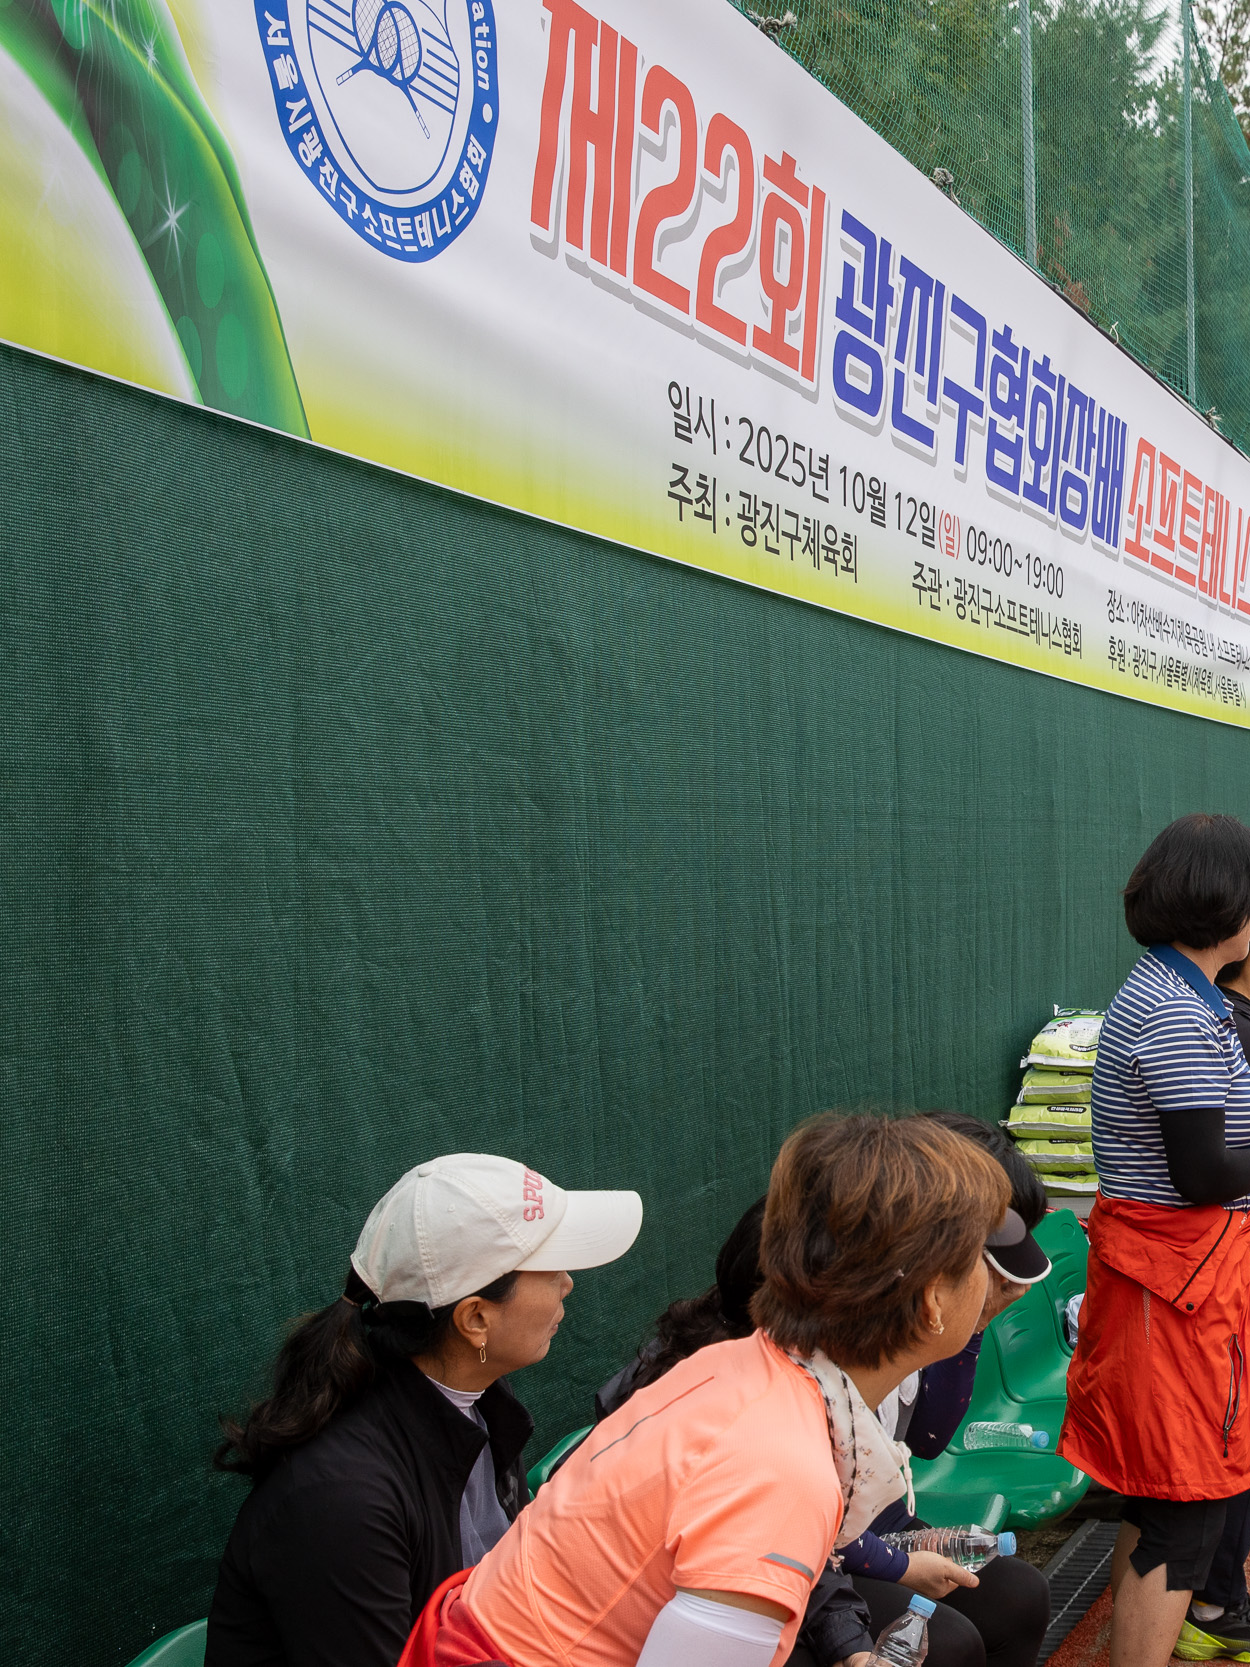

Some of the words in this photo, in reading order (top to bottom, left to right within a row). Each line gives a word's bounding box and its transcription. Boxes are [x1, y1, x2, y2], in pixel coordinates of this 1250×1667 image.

[530, 0, 826, 383] 제22회
[833, 209, 1127, 550] 광진구협회장배
[668, 380, 717, 455] 일시
[738, 416, 829, 503] 2025년
[839, 465, 887, 528] 10월
[966, 526, 1064, 599] 09:00~19:00
[668, 463, 717, 534] 주최
[737, 489, 858, 583] 광진구체육회
[953, 576, 1082, 659] 광진구소프트테니스협회
